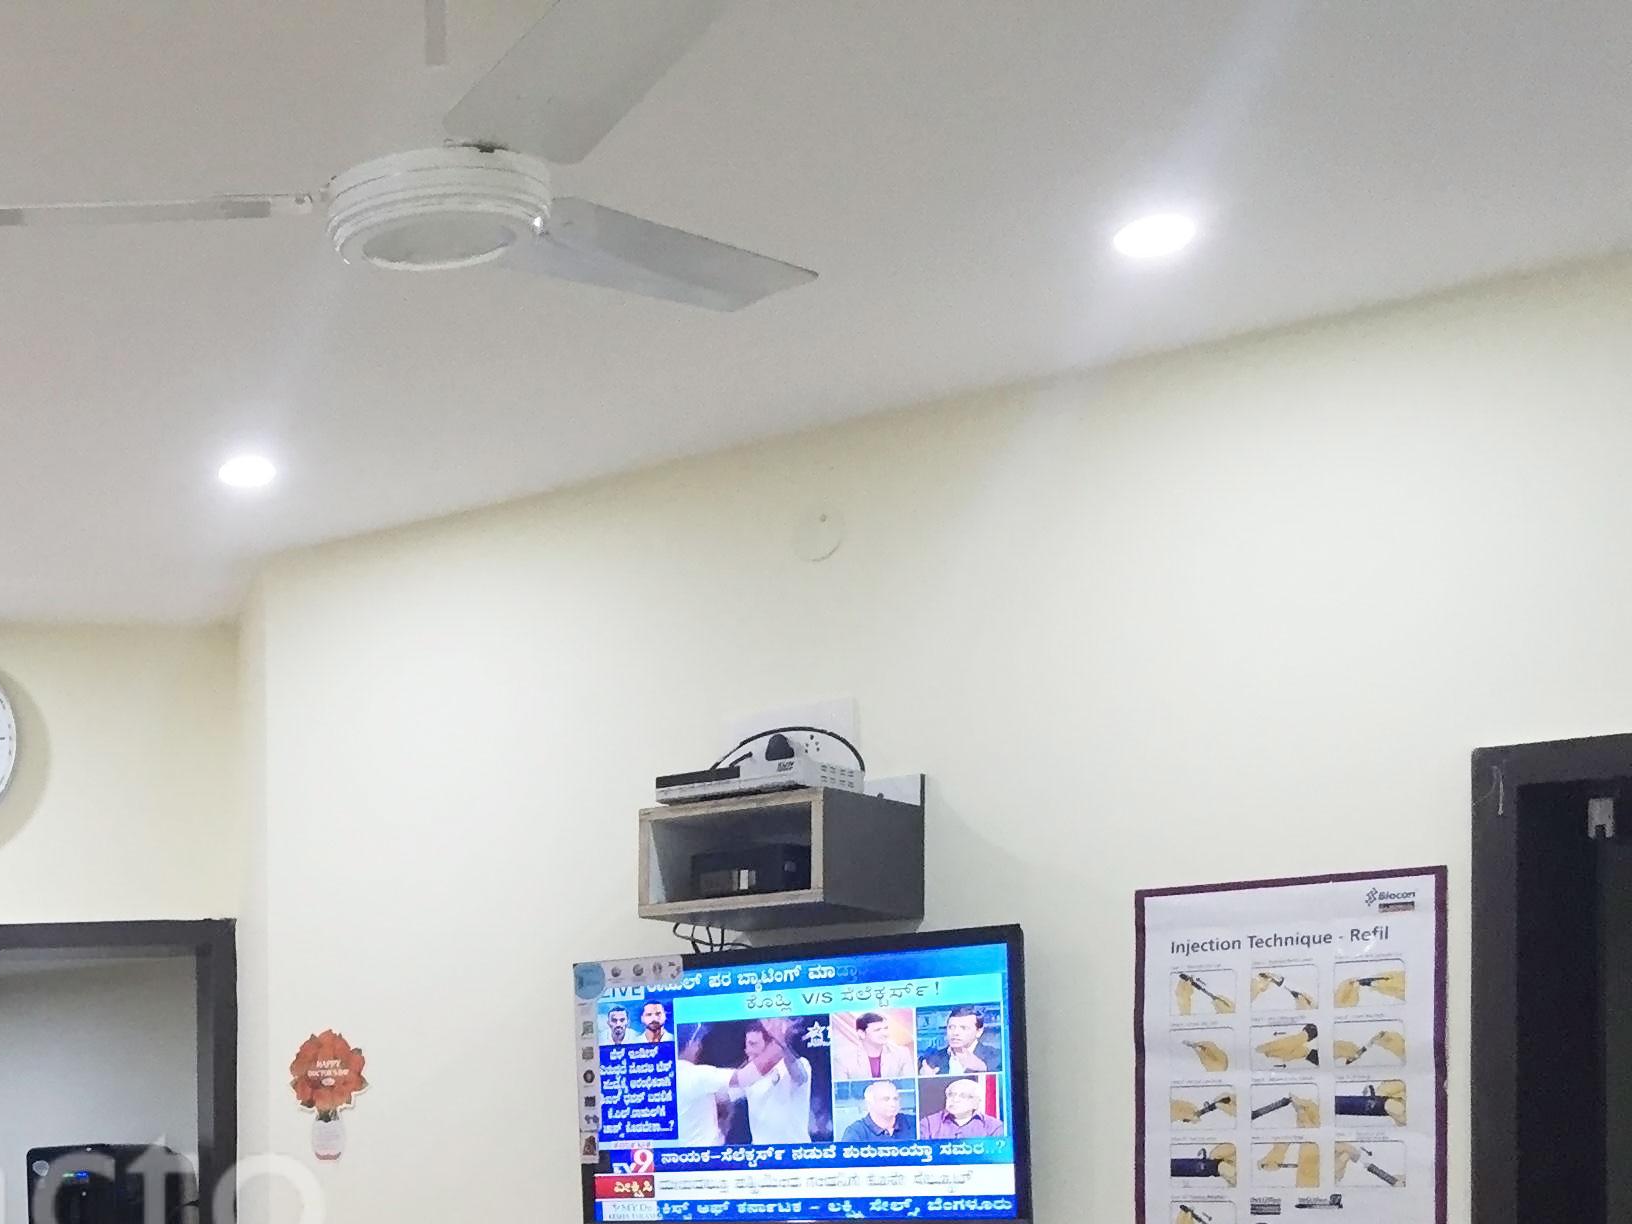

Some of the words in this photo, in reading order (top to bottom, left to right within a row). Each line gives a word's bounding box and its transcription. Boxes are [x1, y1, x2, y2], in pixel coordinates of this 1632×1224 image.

[1170, 938, 1242, 956] Injection
[1247, 931, 1333, 949] Technique
[1350, 925, 1389, 943] Refil
[802, 992, 833, 1004] V/S
[927, 1198, 1013, 1211] ಬೆಂಗಳೂರು
